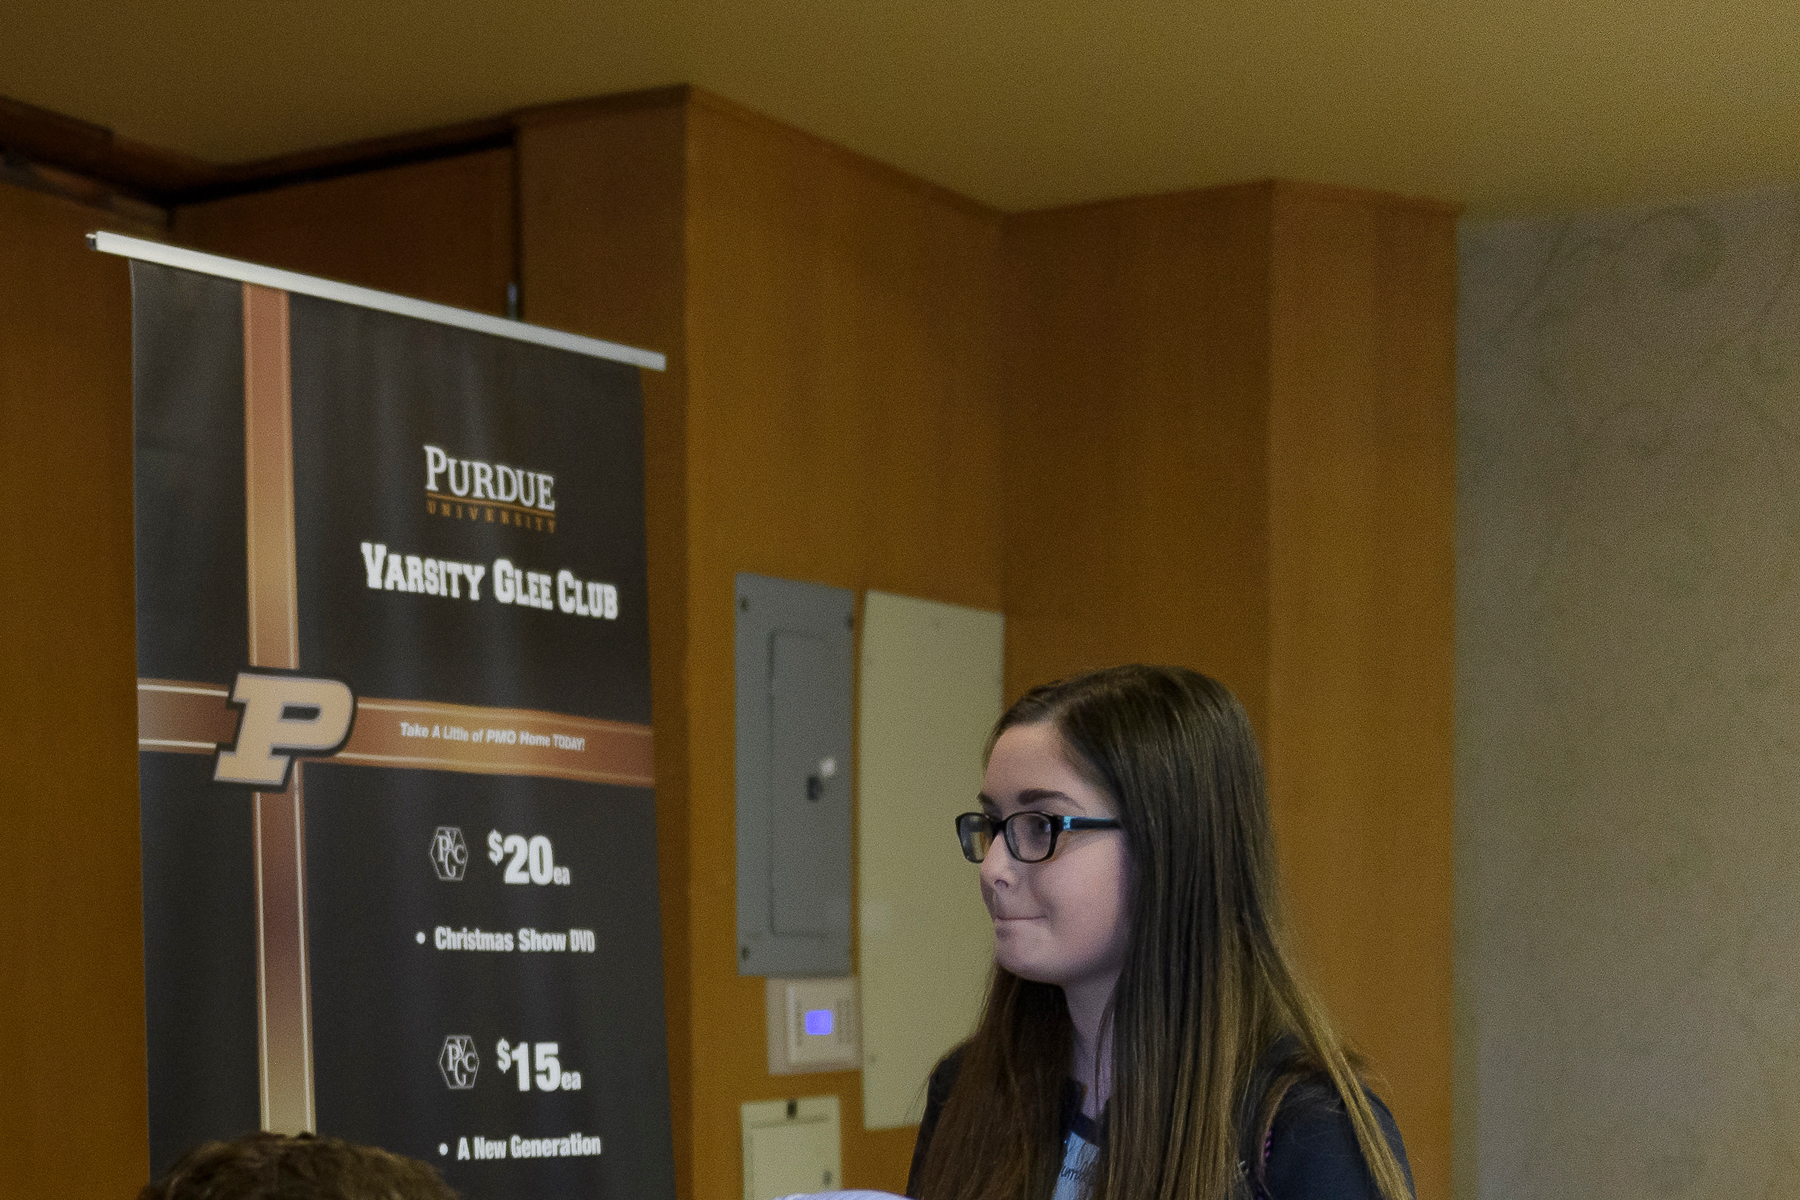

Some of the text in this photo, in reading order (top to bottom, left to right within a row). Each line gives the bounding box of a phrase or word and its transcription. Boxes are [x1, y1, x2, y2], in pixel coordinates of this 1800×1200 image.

[423, 444, 556, 511] PURDUE
[427, 499, 556, 533] UNIVERSITY
[361, 541, 618, 620] VARSITY GLEE CLUB
[214, 672, 354, 785] P
[400, 722, 585, 751] Take A Little of PMO Home TODAY!
[434, 926, 596, 953] Christmas Show DVD
[457, 1132, 601, 1161] A New Generation
